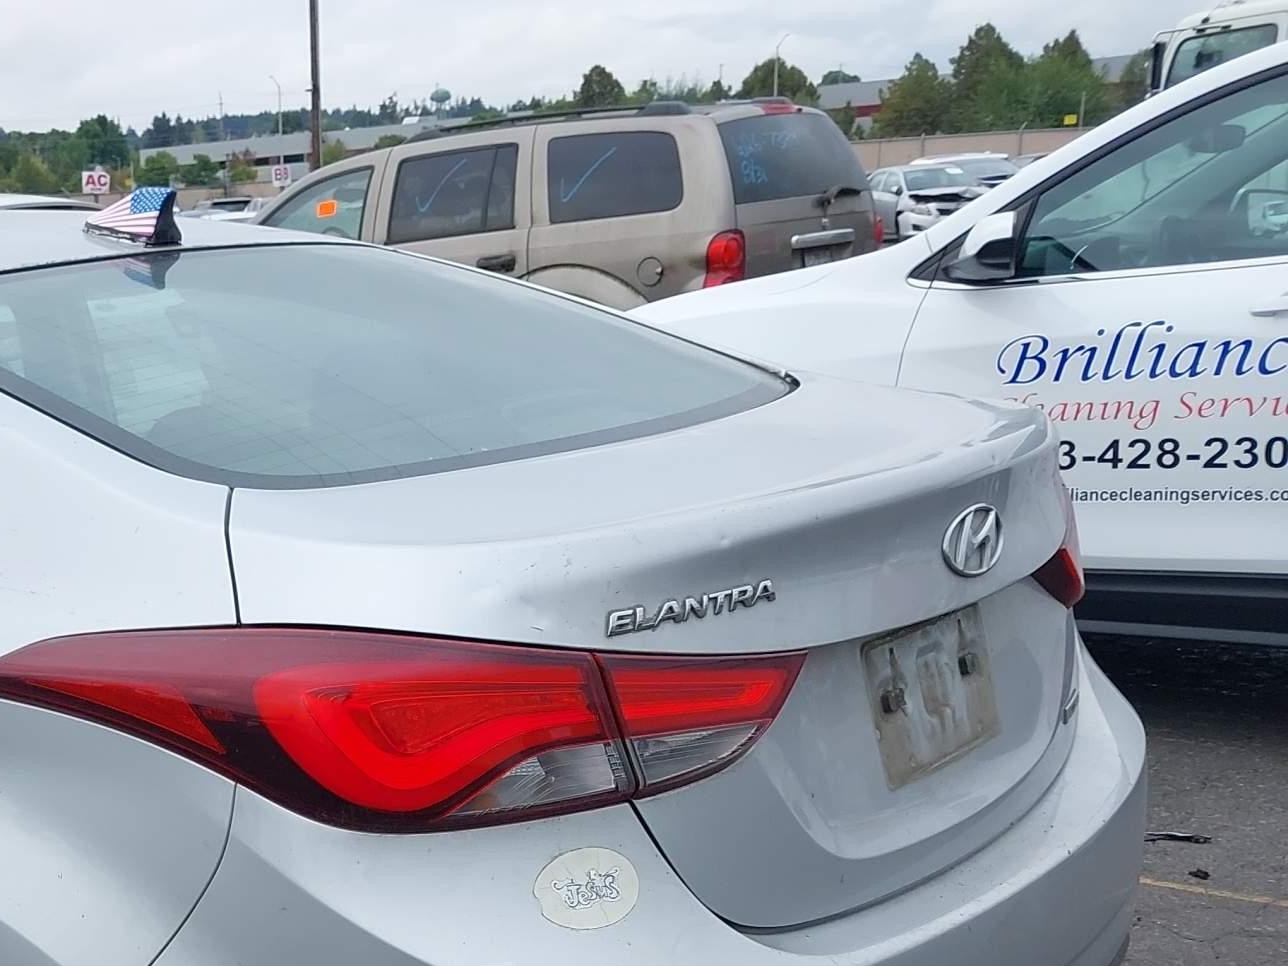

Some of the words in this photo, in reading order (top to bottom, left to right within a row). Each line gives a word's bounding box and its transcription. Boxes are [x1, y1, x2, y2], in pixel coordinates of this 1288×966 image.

[85, 173, 108, 187] AC
[997, 320, 1288, 385] Brillianc
[1173, 391, 1288, 420] Servi
[606, 579, 777, 637] ELANTRA
